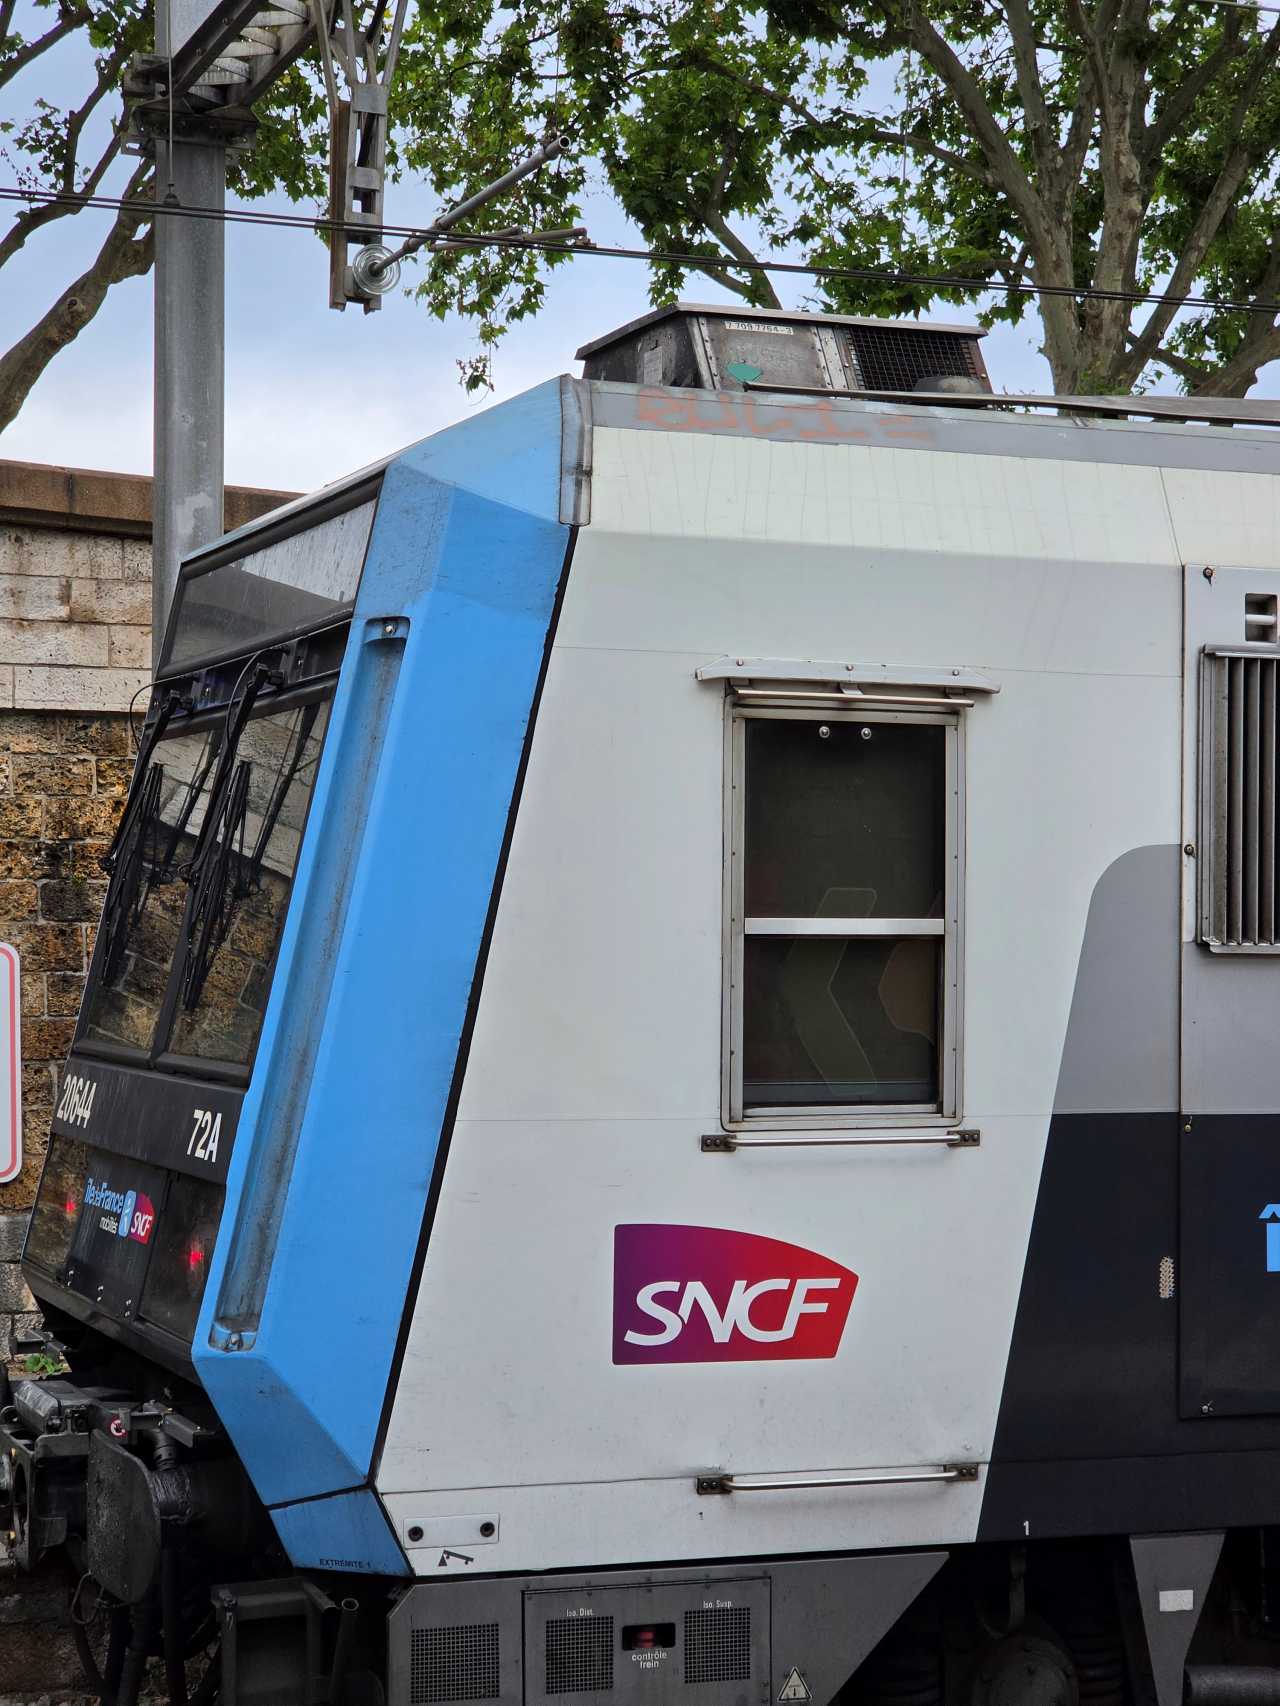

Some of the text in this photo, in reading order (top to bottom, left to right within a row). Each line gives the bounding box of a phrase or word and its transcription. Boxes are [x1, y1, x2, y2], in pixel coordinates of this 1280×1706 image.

[56, 1074, 97, 1129] 20644
[186, 1109, 223, 1163] 72A
[130, 1211, 153, 1237] SNCF
[624, 1278, 841, 1347] SNCF
[1023, 1520, 1030, 1537] 1
[631, 1650, 668, 1662] contrôle
[639, 1660, 660, 1670] frein
